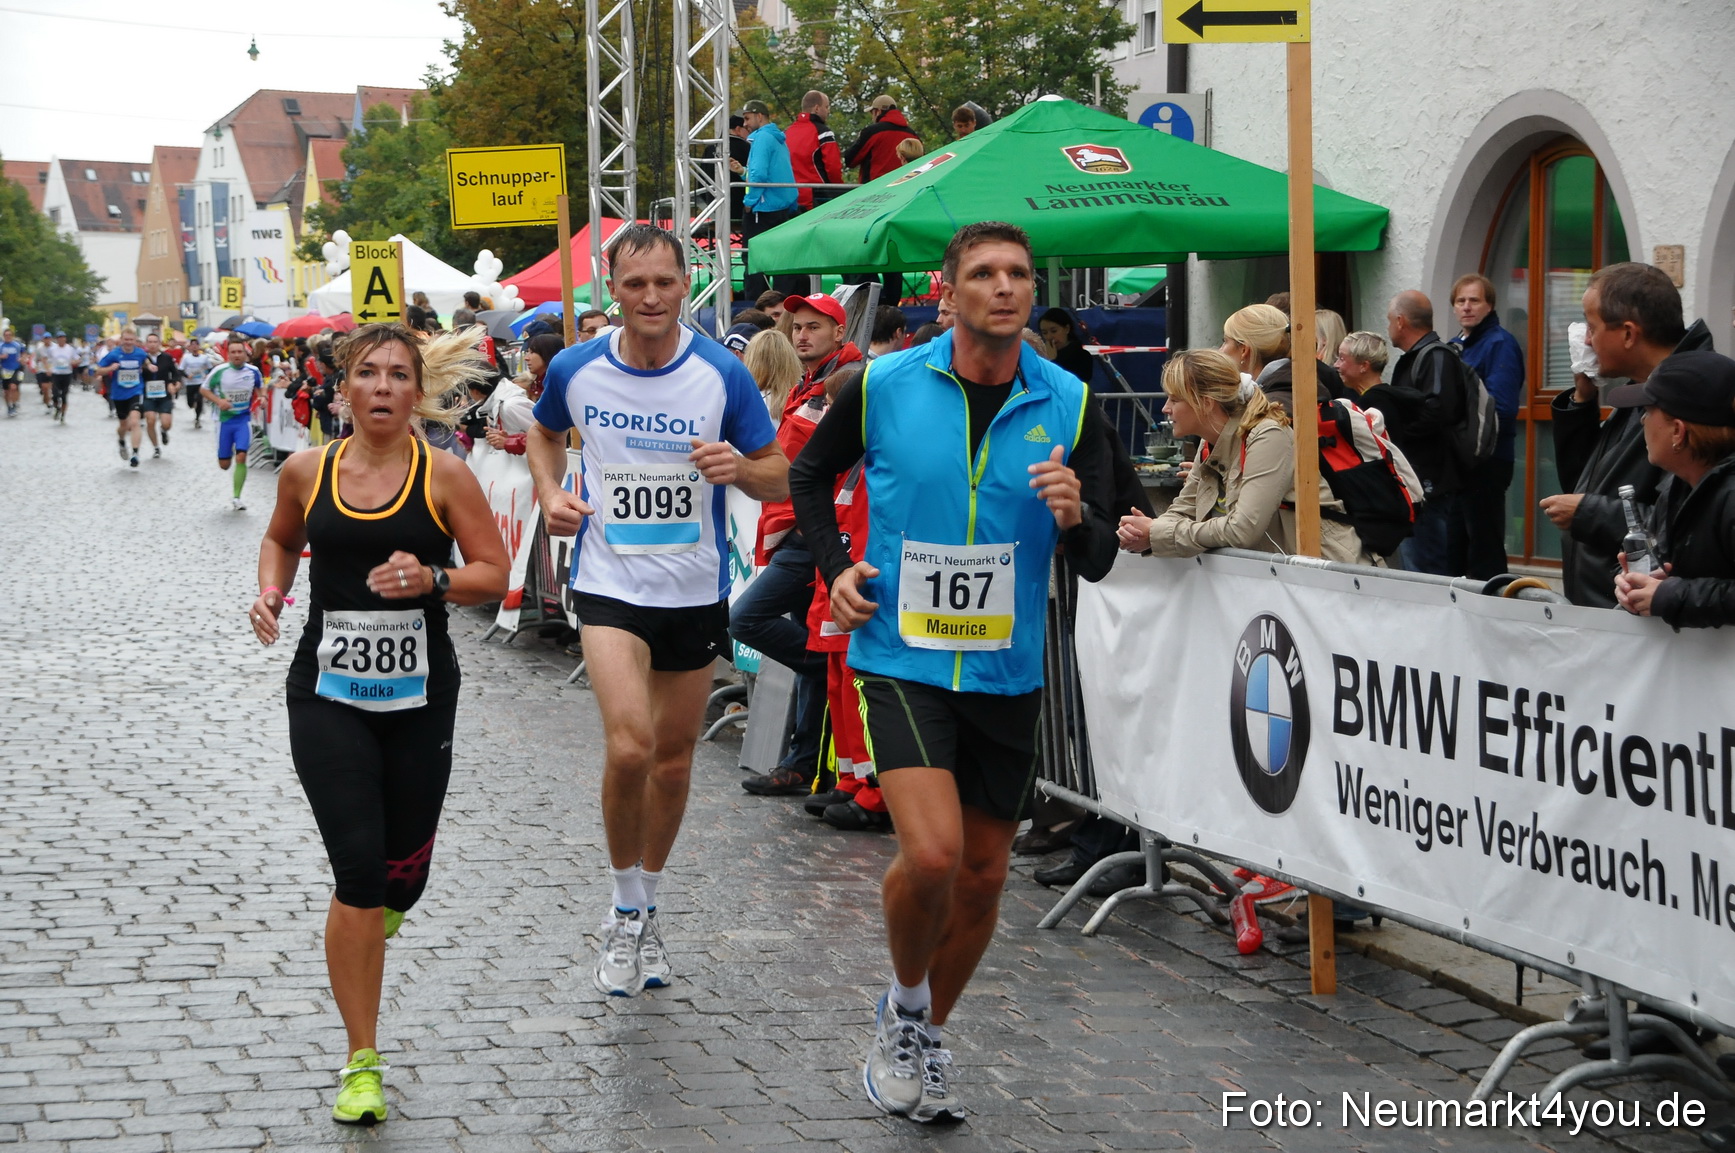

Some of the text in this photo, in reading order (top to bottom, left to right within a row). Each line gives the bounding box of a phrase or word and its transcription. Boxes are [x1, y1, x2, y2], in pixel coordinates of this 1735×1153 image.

[456, 170, 556, 188] Schnupper-
[1044, 180, 1191, 195] Neumarkter
[492, 191, 524, 206] lauf
[1024, 192, 1231, 211] Lammsbräu
[355, 245, 397, 259] Block
[363, 266, 394, 305] A
[227, 288, 238, 303] B
[629, 439, 694, 451] HAUTKLINIK
[1023, 434, 1051, 443] adidas
[604, 472, 685, 482] PARTL Neumarkt
[613, 485, 693, 520] 3093
[904, 551, 996, 566] PARTL Neumarkt
[925, 570, 994, 610] 167
[326, 620, 409, 632] PARTL Neumarkt
[926, 618, 987, 636] Maurice
[330, 635, 418, 674] 2388
[1236, 619, 1302, 688] BMW
[350, 682, 394, 698] Radka
[1331, 653, 1461, 761] BMW
[1334, 760, 1468, 852] Weniger
[1473, 795, 1678, 910] Verbrauch.
